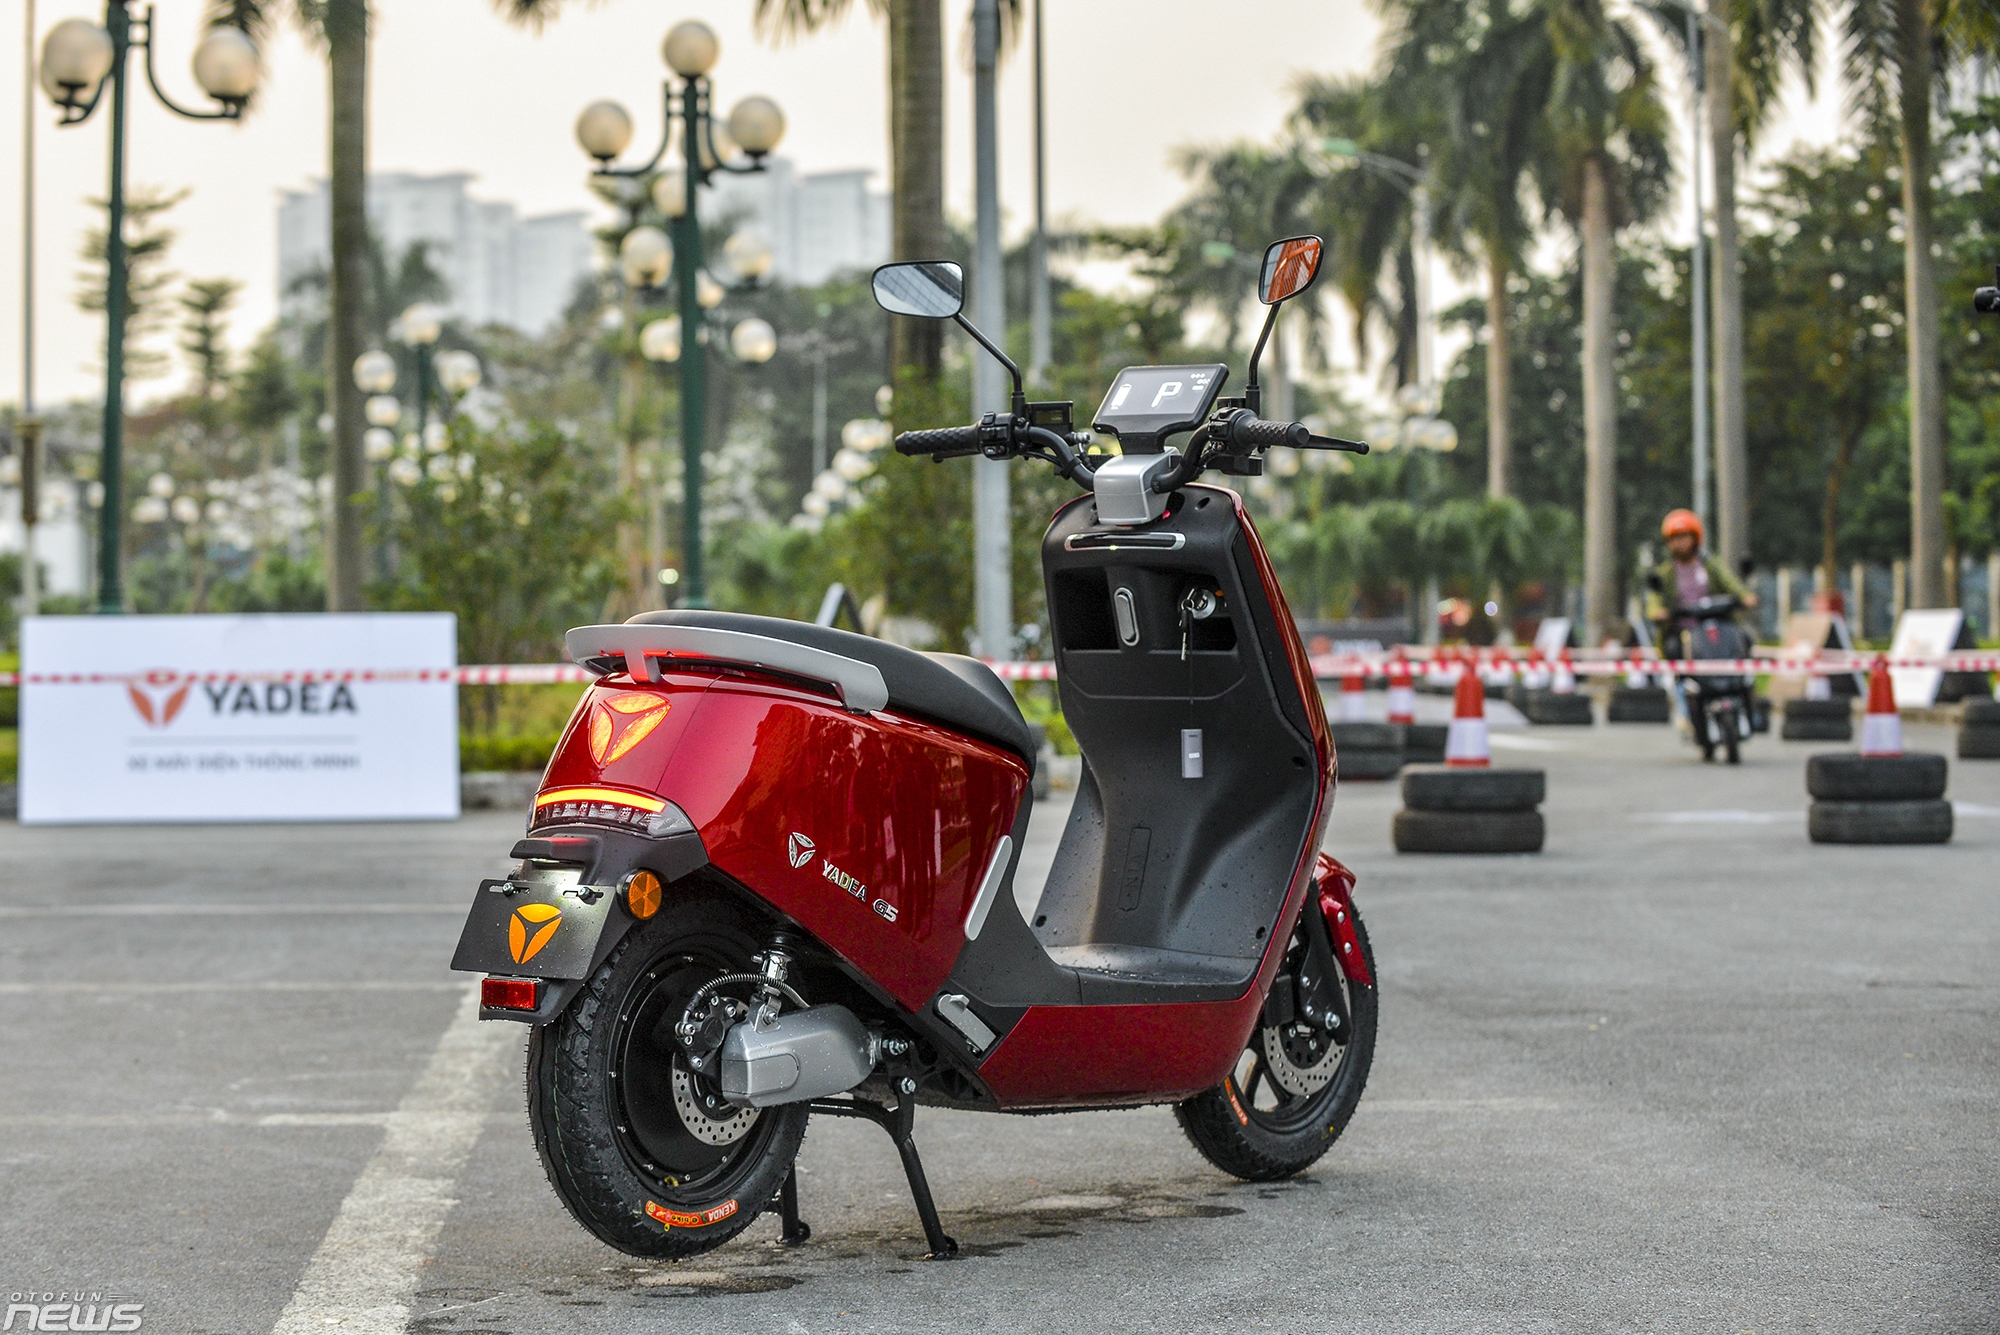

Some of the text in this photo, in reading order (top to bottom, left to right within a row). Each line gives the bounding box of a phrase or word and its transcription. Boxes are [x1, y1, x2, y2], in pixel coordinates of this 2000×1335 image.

[1151, 381, 1183, 408] P
[204, 681, 358, 715] YADEA
[822, 859, 899, 923] YADEA G5
[708, 1201, 736, 1222] KENDA
